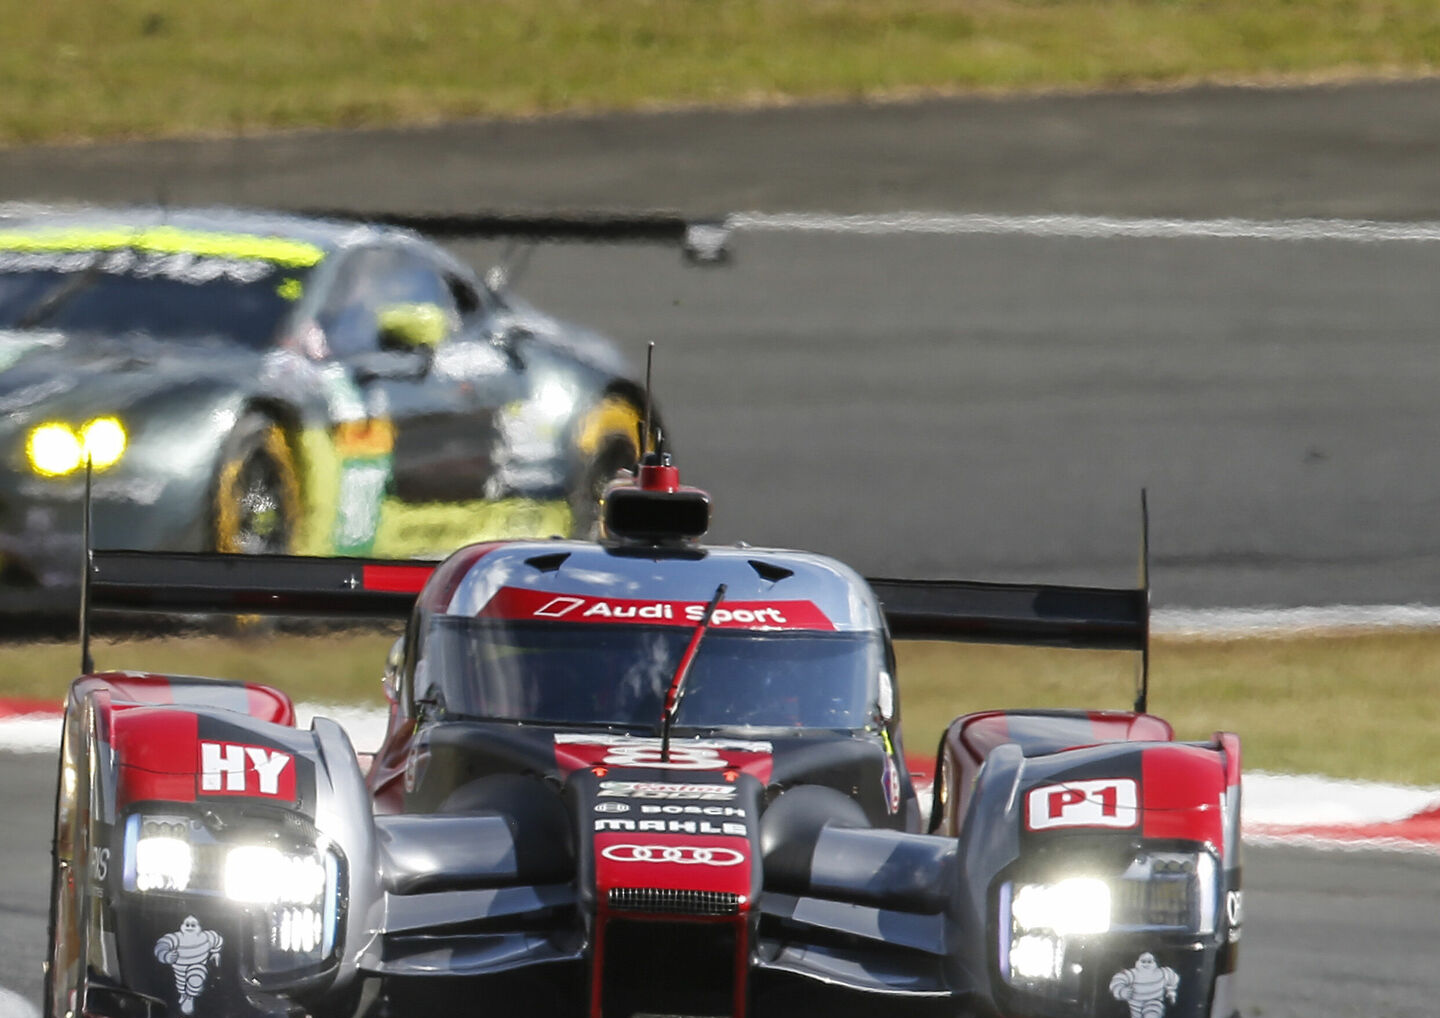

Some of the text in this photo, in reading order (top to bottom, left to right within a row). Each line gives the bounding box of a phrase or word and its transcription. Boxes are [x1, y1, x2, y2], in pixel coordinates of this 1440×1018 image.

[583, 602, 787, 625] Audi Sport
[201, 742, 290, 795] HY
[603, 746, 729, 769] 8
[641, 805, 746, 817] BOSCH
[1048, 786, 1118, 819] P1
[595, 819, 747, 835] MAHLE
